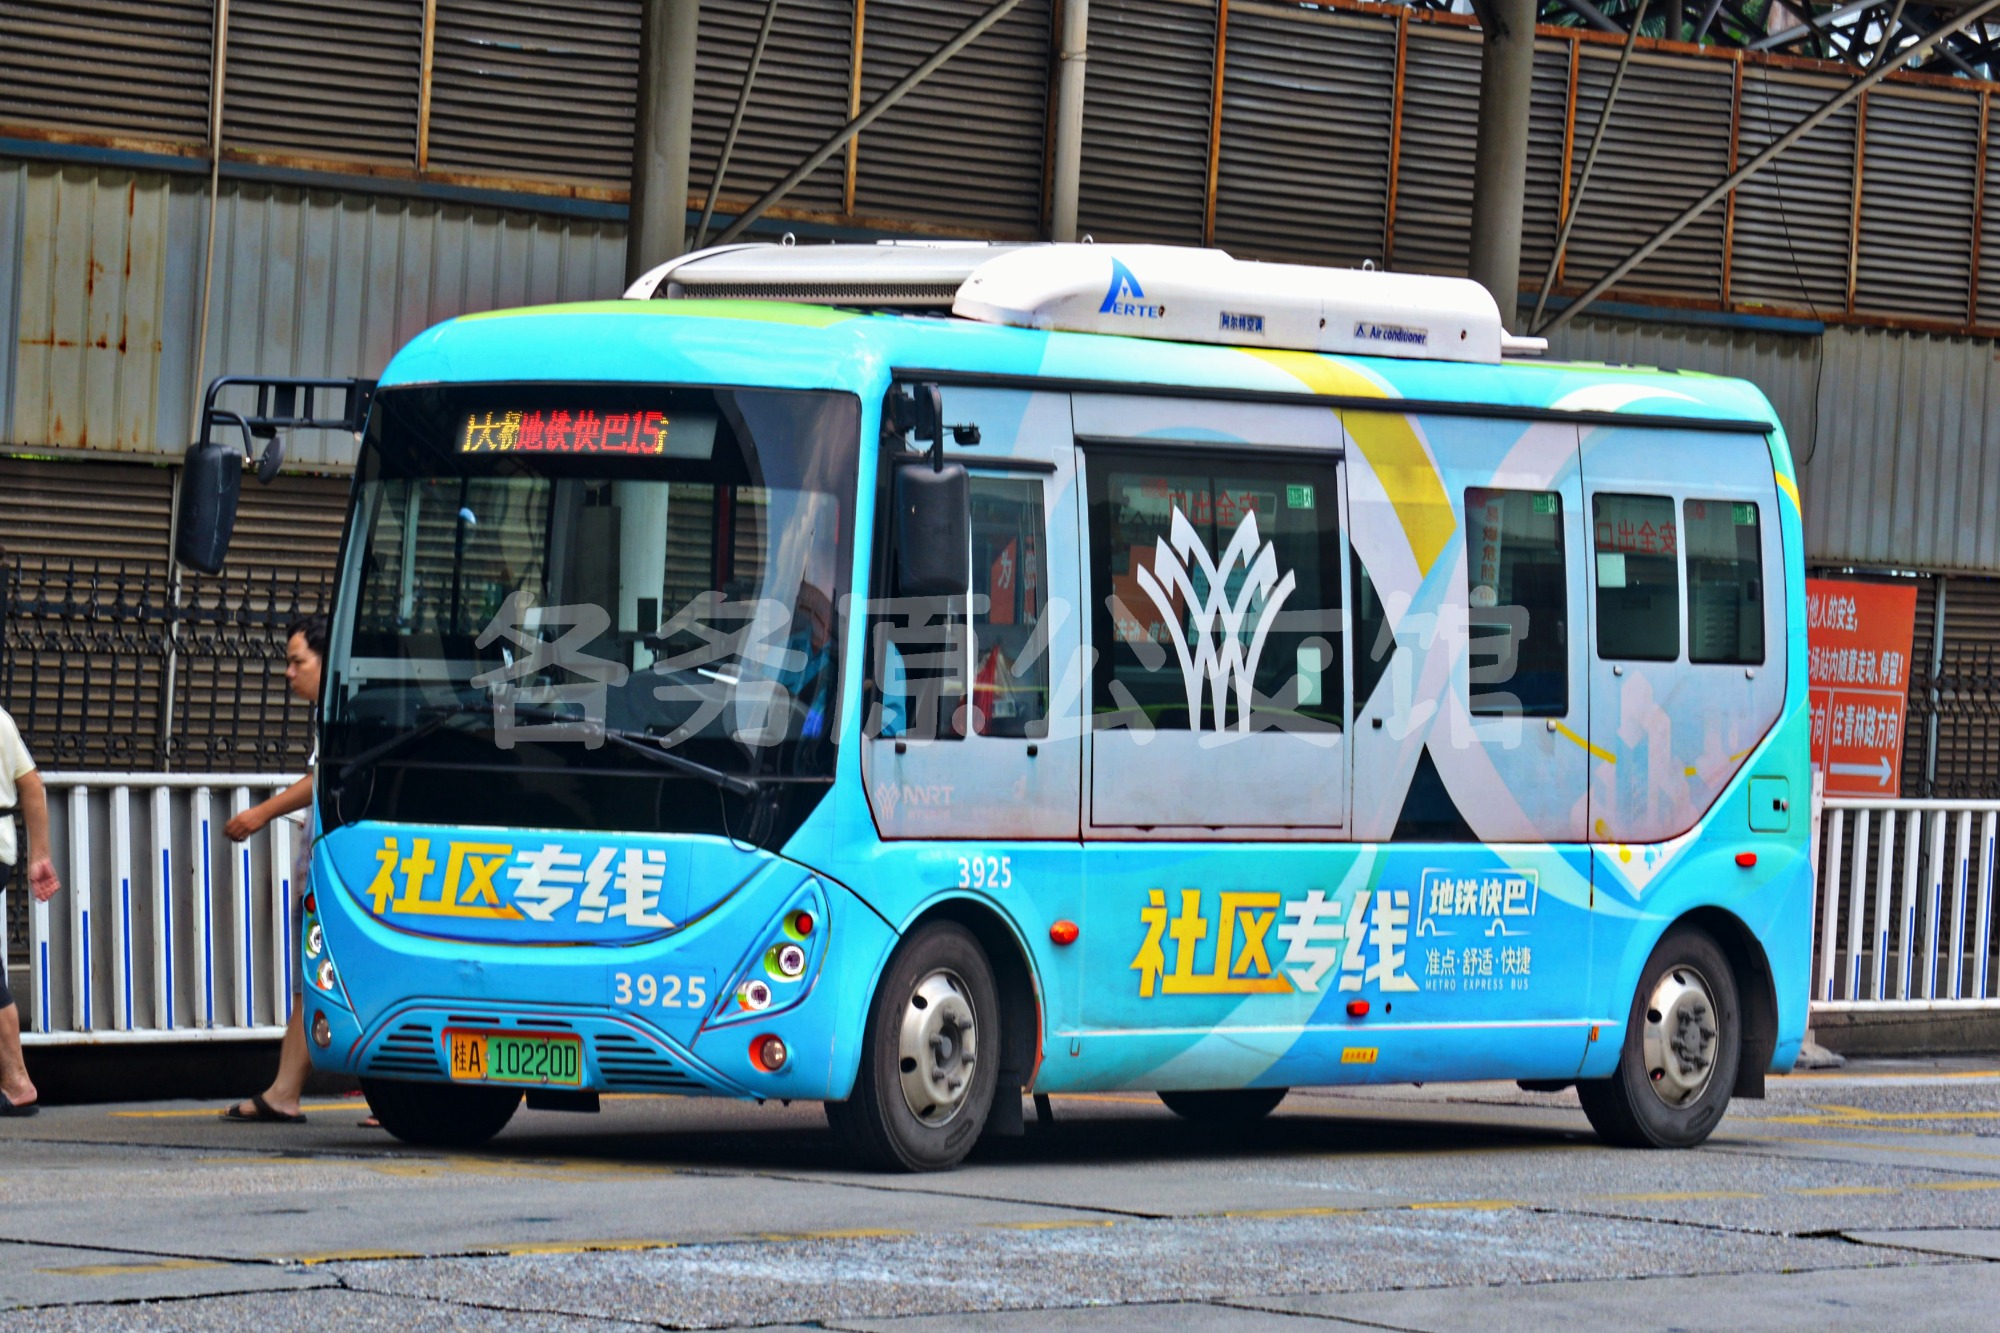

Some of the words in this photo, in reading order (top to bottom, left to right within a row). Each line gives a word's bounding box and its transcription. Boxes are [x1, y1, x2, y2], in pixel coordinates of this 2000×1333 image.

[1221, 312, 1264, 333] 阿尔特空调
[1369, 324, 1382, 340] Air
[1383, 327, 1427, 345] conditioner
[1832, 702, 1898, 749] 往青林路方向
[366, 836, 677, 928] 社区专线
[958, 856, 1012, 889] 3925
[1428, 877, 1531, 917] 地铁快巴
[1130, 888, 1420, 998] 社区专线
[613, 972, 707, 1009] 3925
[1425, 979, 1457, 992] METRO
[1463, 978, 1504, 991] EXPRESS
[1511, 977, 1530, 991] BUS
[453, 1038, 481, 1073] 桂A
[494, 1041, 579, 1078] 10220D
